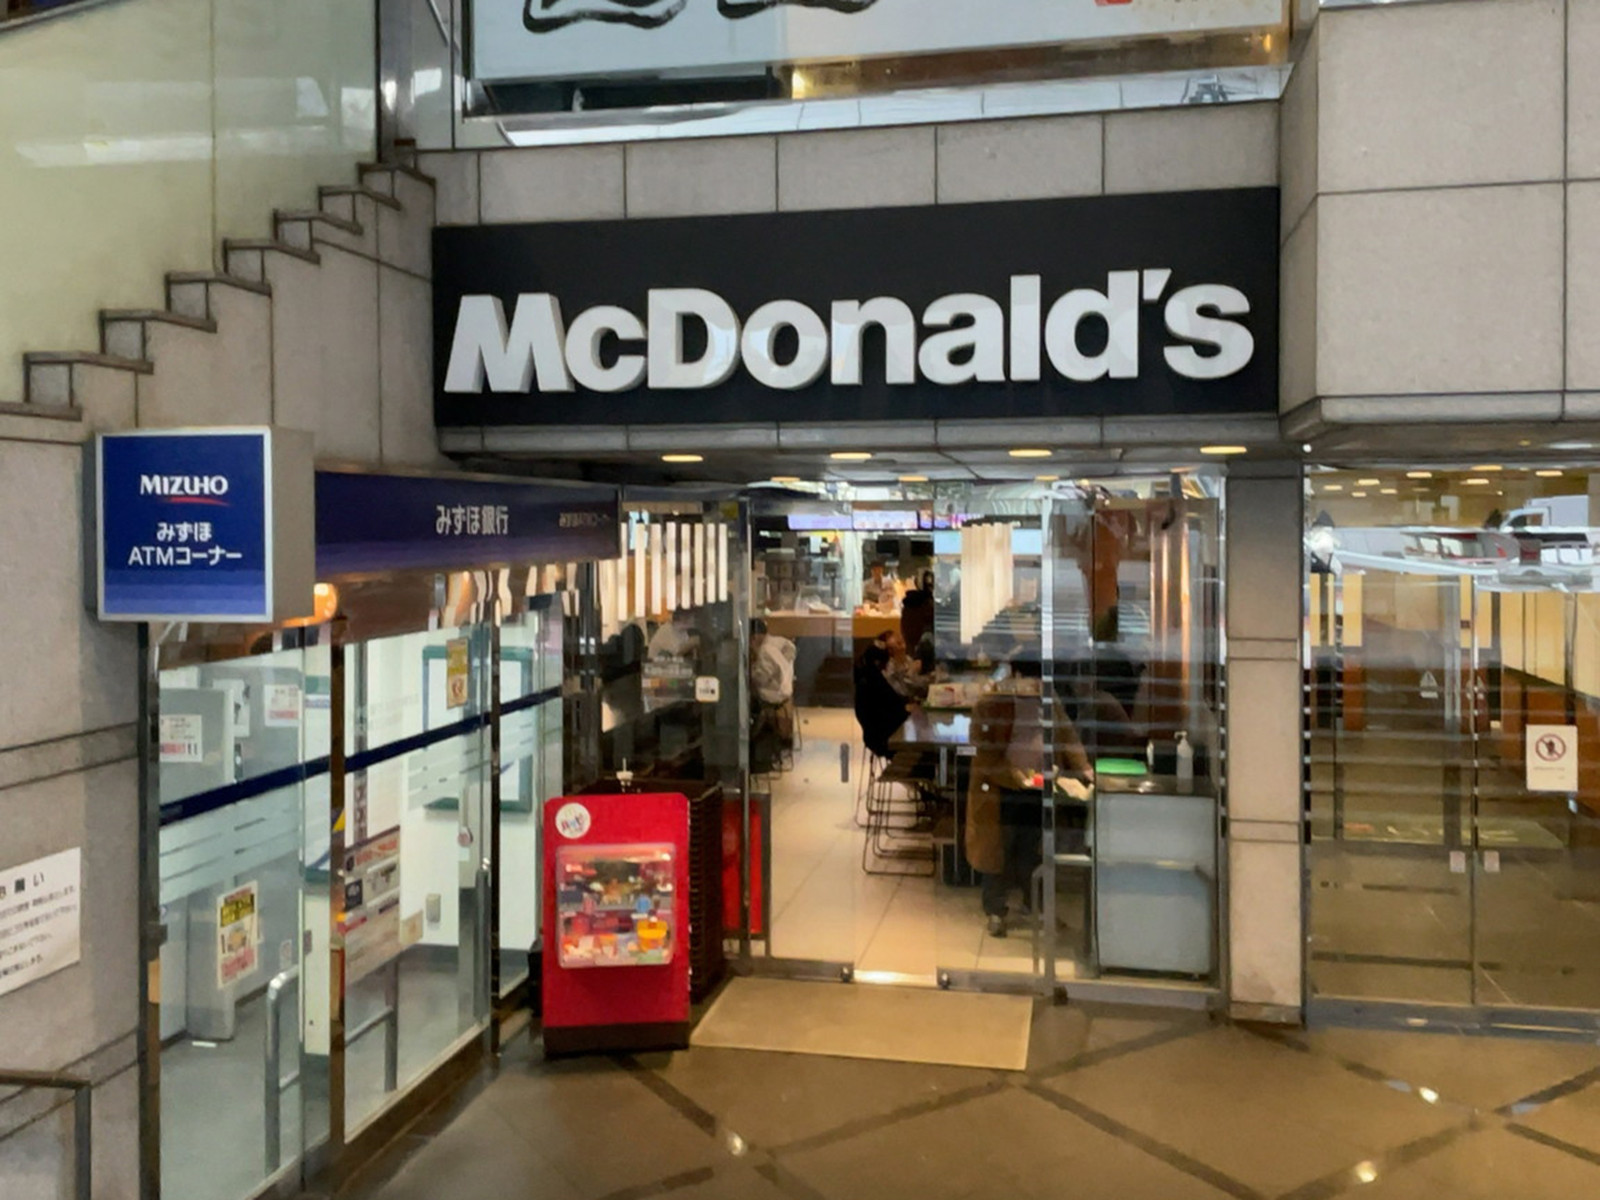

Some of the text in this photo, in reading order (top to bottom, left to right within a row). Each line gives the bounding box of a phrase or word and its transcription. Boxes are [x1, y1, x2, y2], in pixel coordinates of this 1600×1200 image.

[444, 268, 1255, 393] McDonald's
[140, 474, 229, 496] MIZUHO
[435, 503, 509, 536] みずほ銀行
[156, 521, 212, 543] みずほ
[127, 545, 243, 566] ATMコーナー
